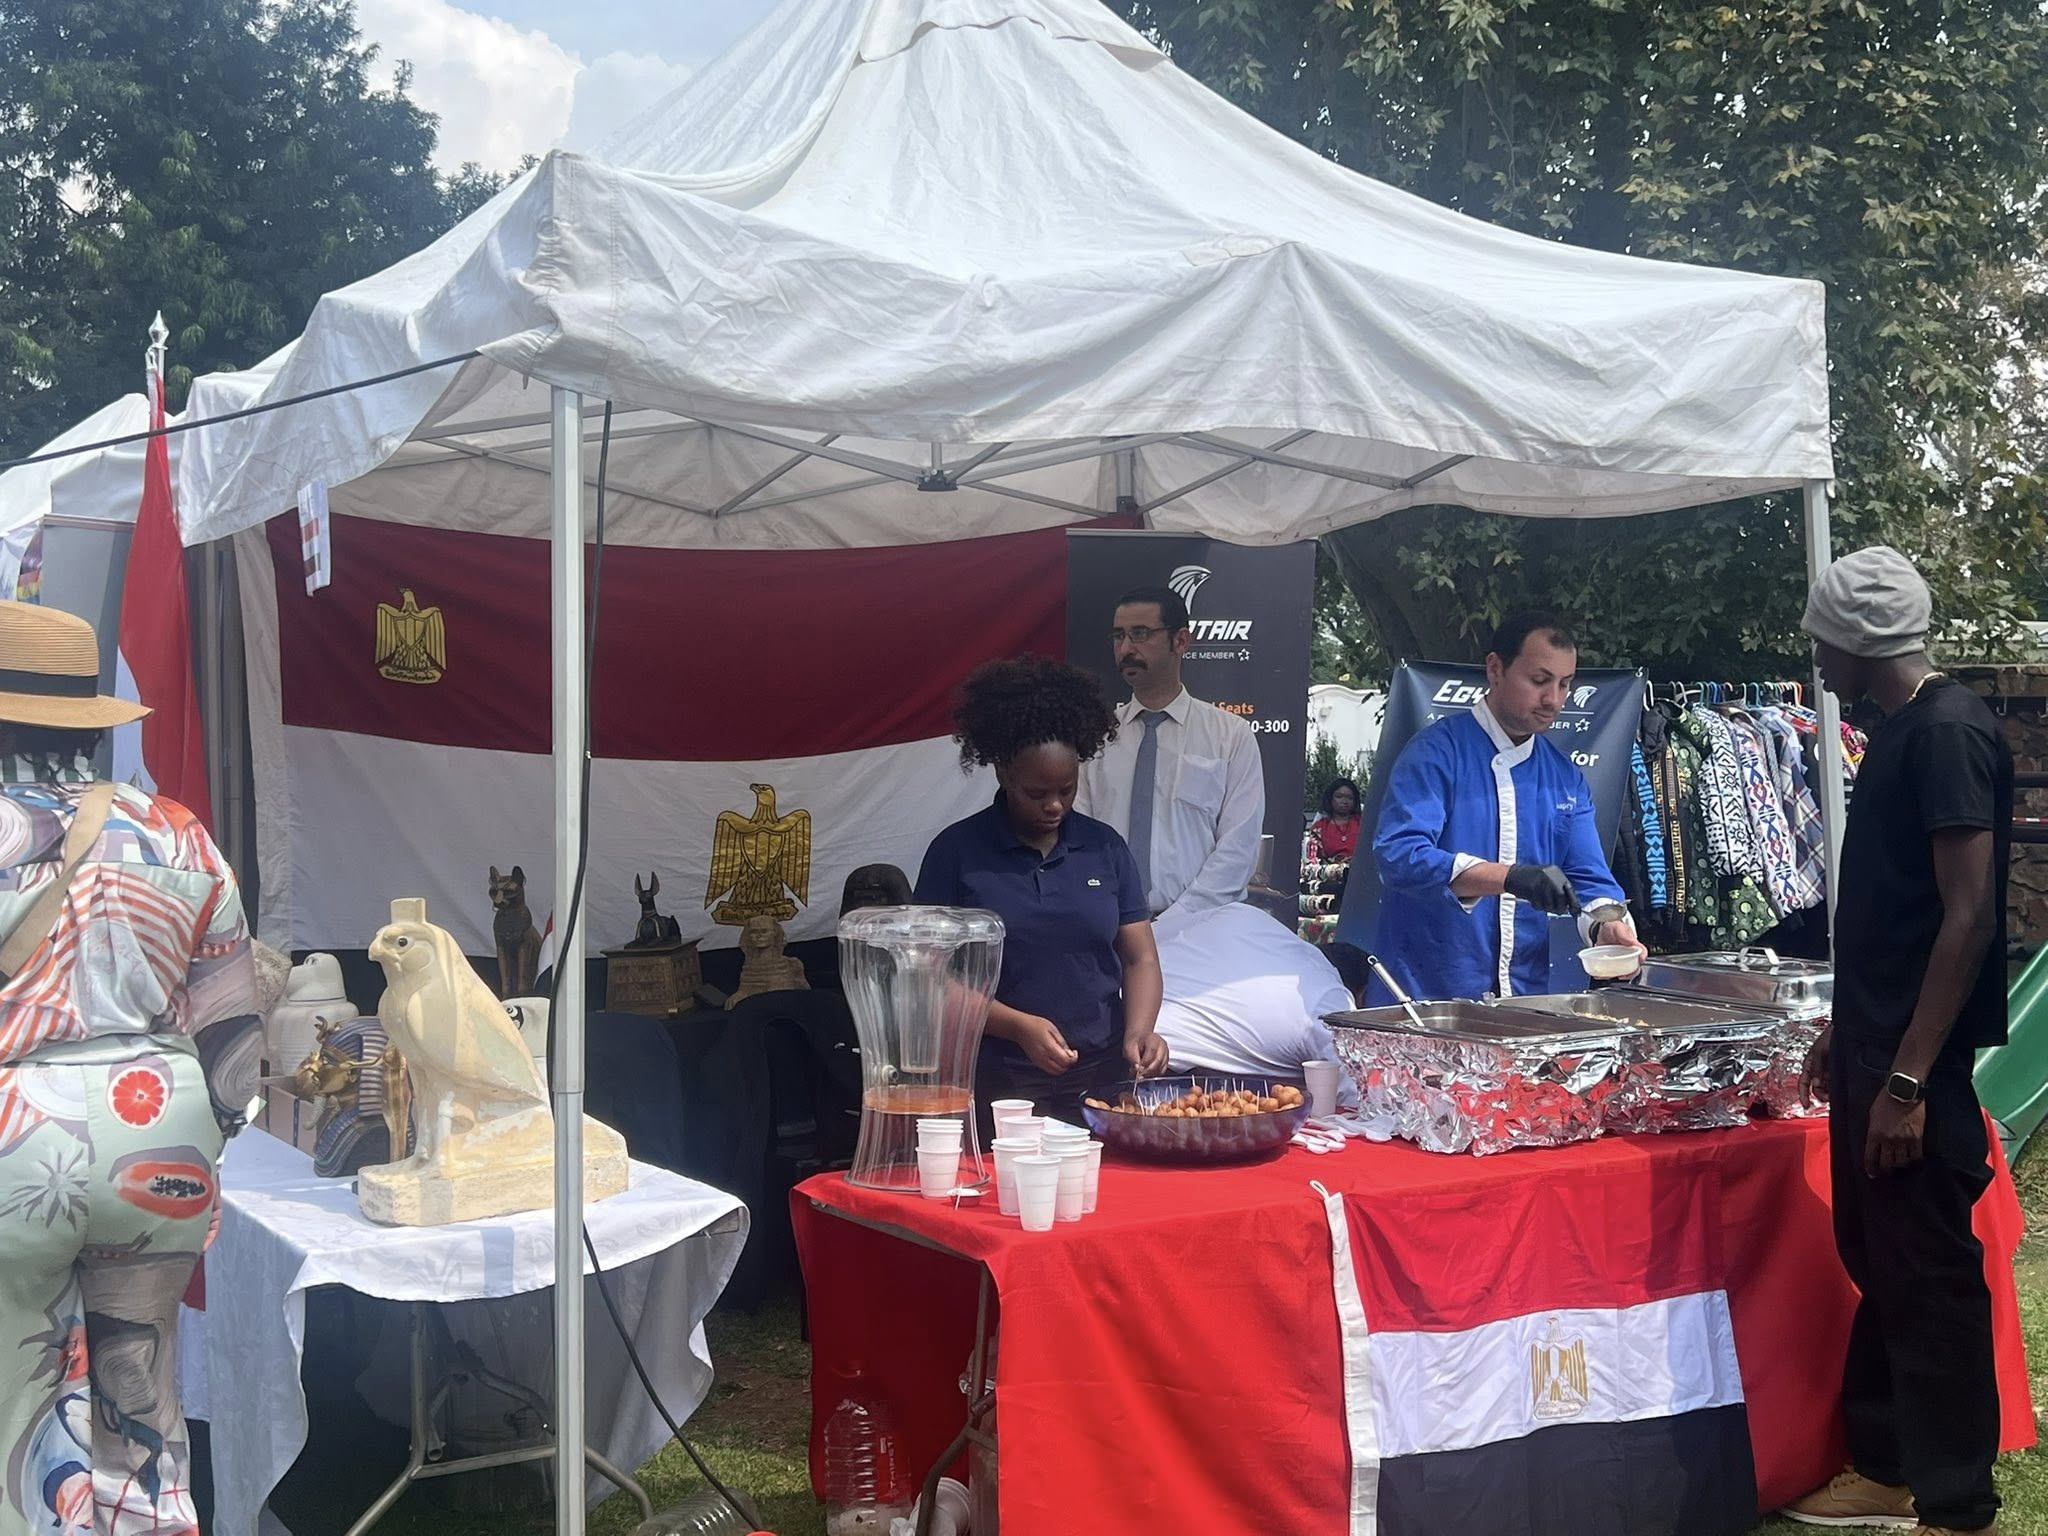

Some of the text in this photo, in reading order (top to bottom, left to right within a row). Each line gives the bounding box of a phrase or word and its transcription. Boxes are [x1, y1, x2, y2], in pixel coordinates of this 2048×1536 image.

[1198, 651, 1235, 660] MEMBER
[1218, 702, 1255, 714] Seats
[1570, 750, 1600, 767] for
